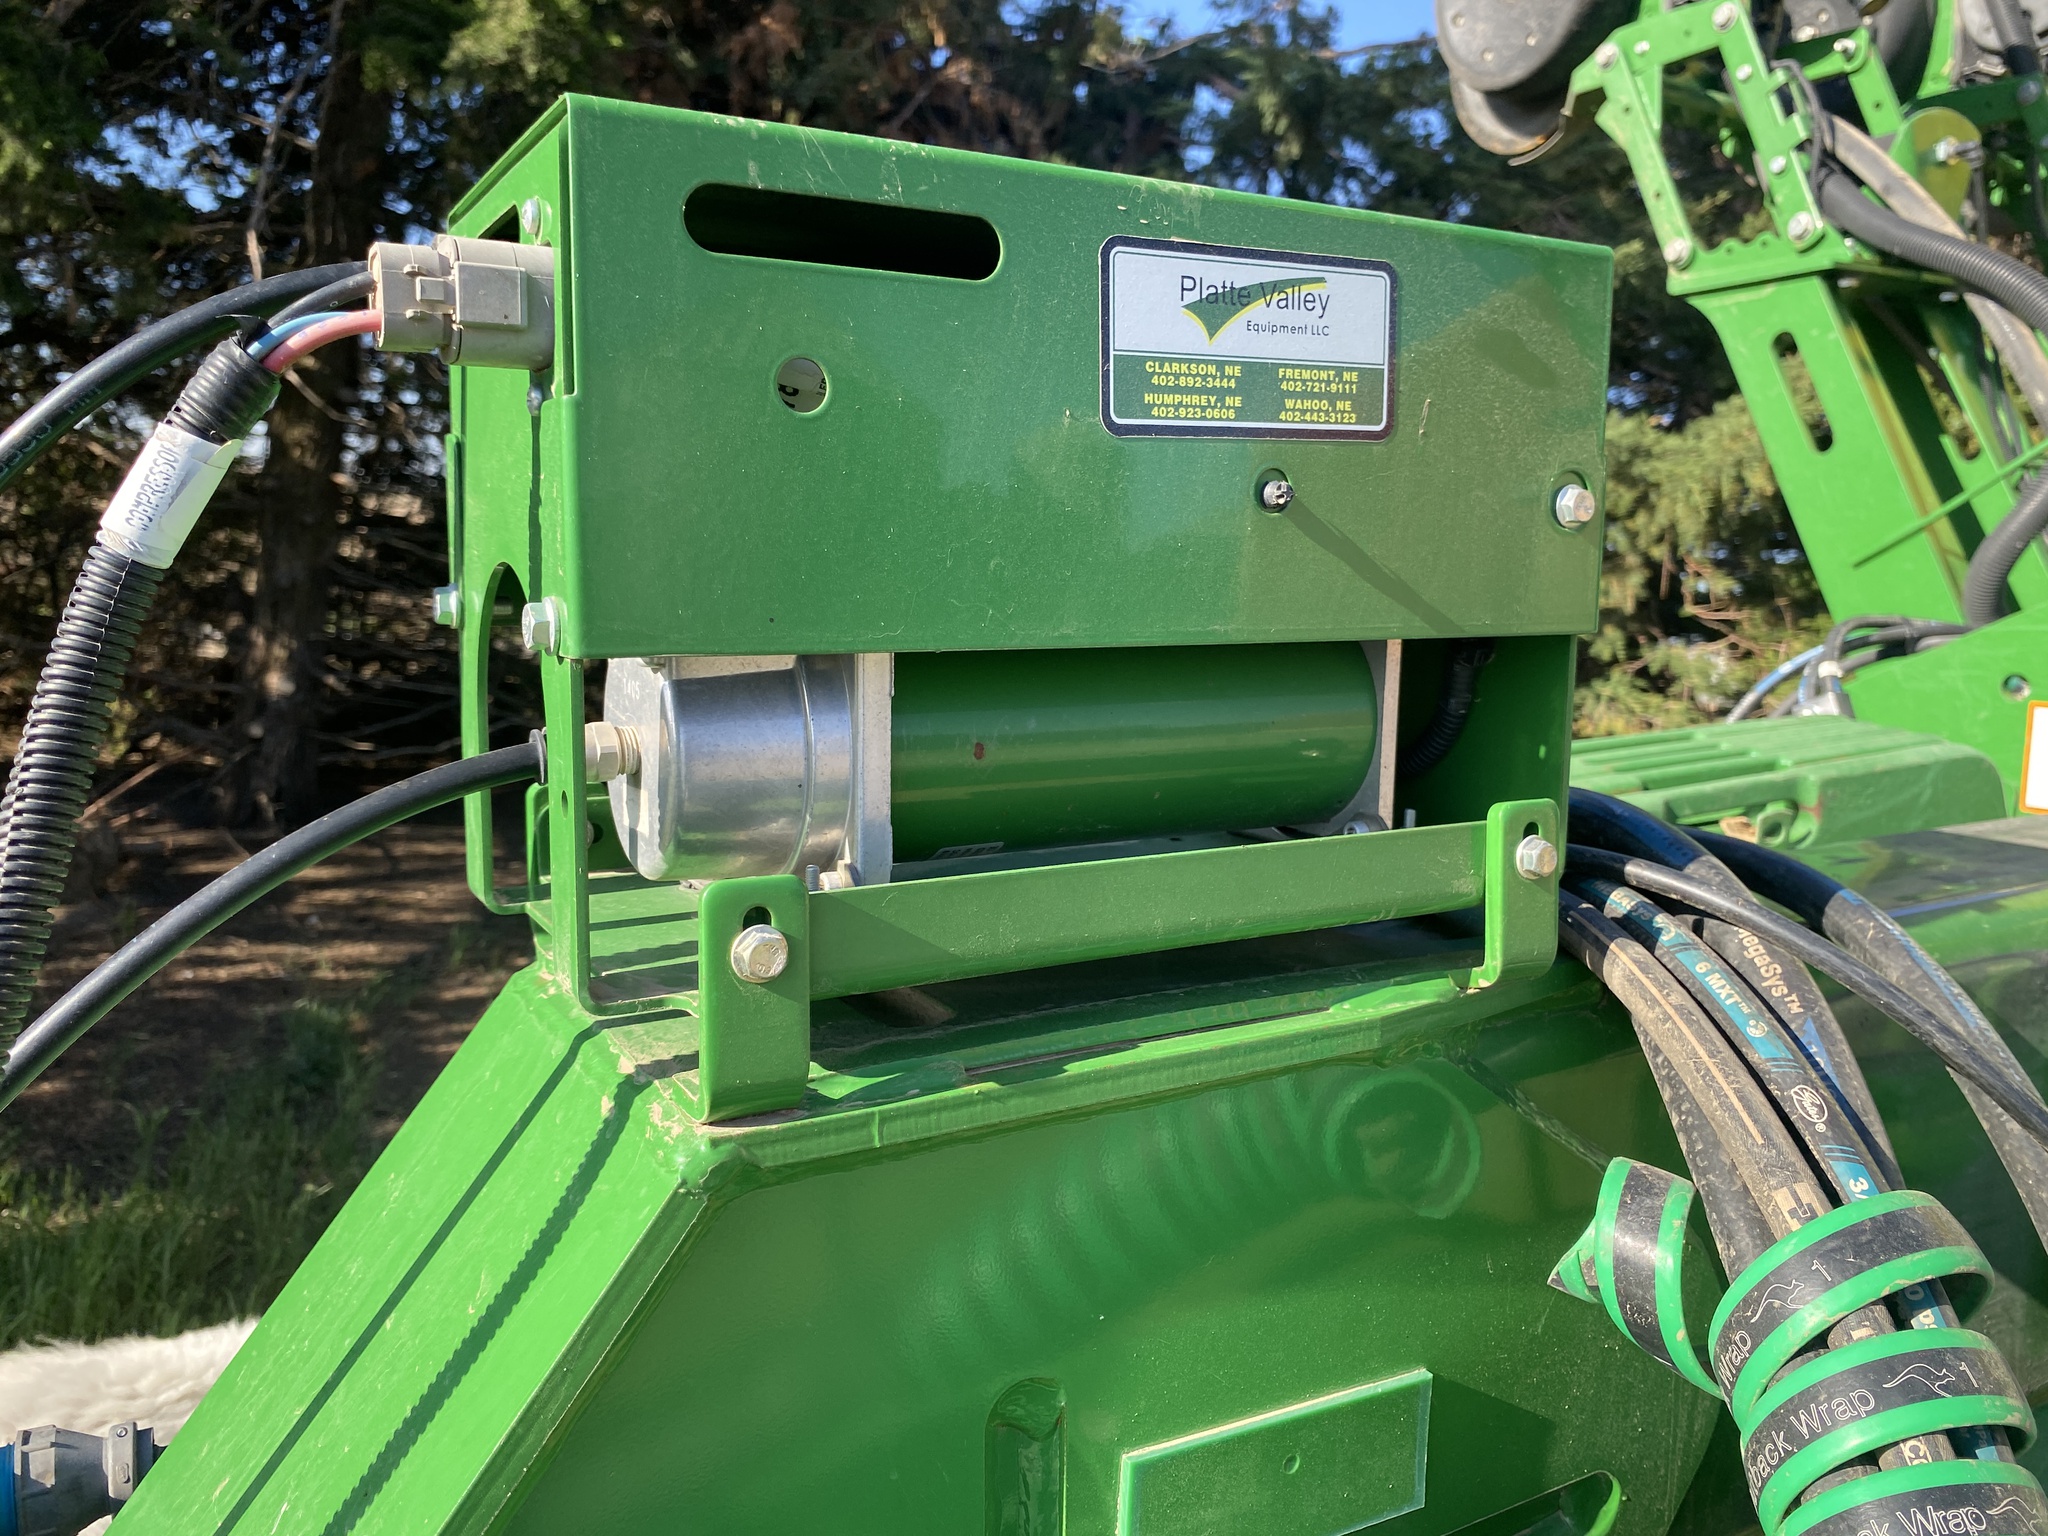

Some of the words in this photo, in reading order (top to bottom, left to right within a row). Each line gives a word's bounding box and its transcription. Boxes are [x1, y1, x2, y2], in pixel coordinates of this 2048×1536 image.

[1180, 275, 1250, 306] Platte
[1260, 282, 1330, 319] Valley
[1246, 320, 1308, 335] Equipment
[1310, 325, 1330, 336] LLC
[1145, 361, 1220, 377] CLARKSON,
[1224, 365, 1242, 376] NE
[1278, 368, 1339, 383] FREMONT,
[1342, 371, 1358, 382] NE
[1151, 375, 1236, 389] 402-892-3444
[1280, 381, 1357, 394] 402-721-9111
[1144, 393, 1221, 408] HUMPHREY,
[1225, 396, 1242, 407] NE
[1284, 398, 1332, 412] WAHOO,
[1336, 400, 1352, 411] NE
[1151, 406, 1236, 419] 402-923-0606
[1279, 411, 1356, 423] 402-443-3123
[1695, 961, 1711, 973] 6
[1718, 1330, 1751, 1390] Wrap
[1811, 1259, 1832, 1282] 1
[1790, 1389, 1875, 1439] Wrap
[1959, 1361, 1979, 1388] 1
[1896, 1505, 1986, 1536] Wrap
